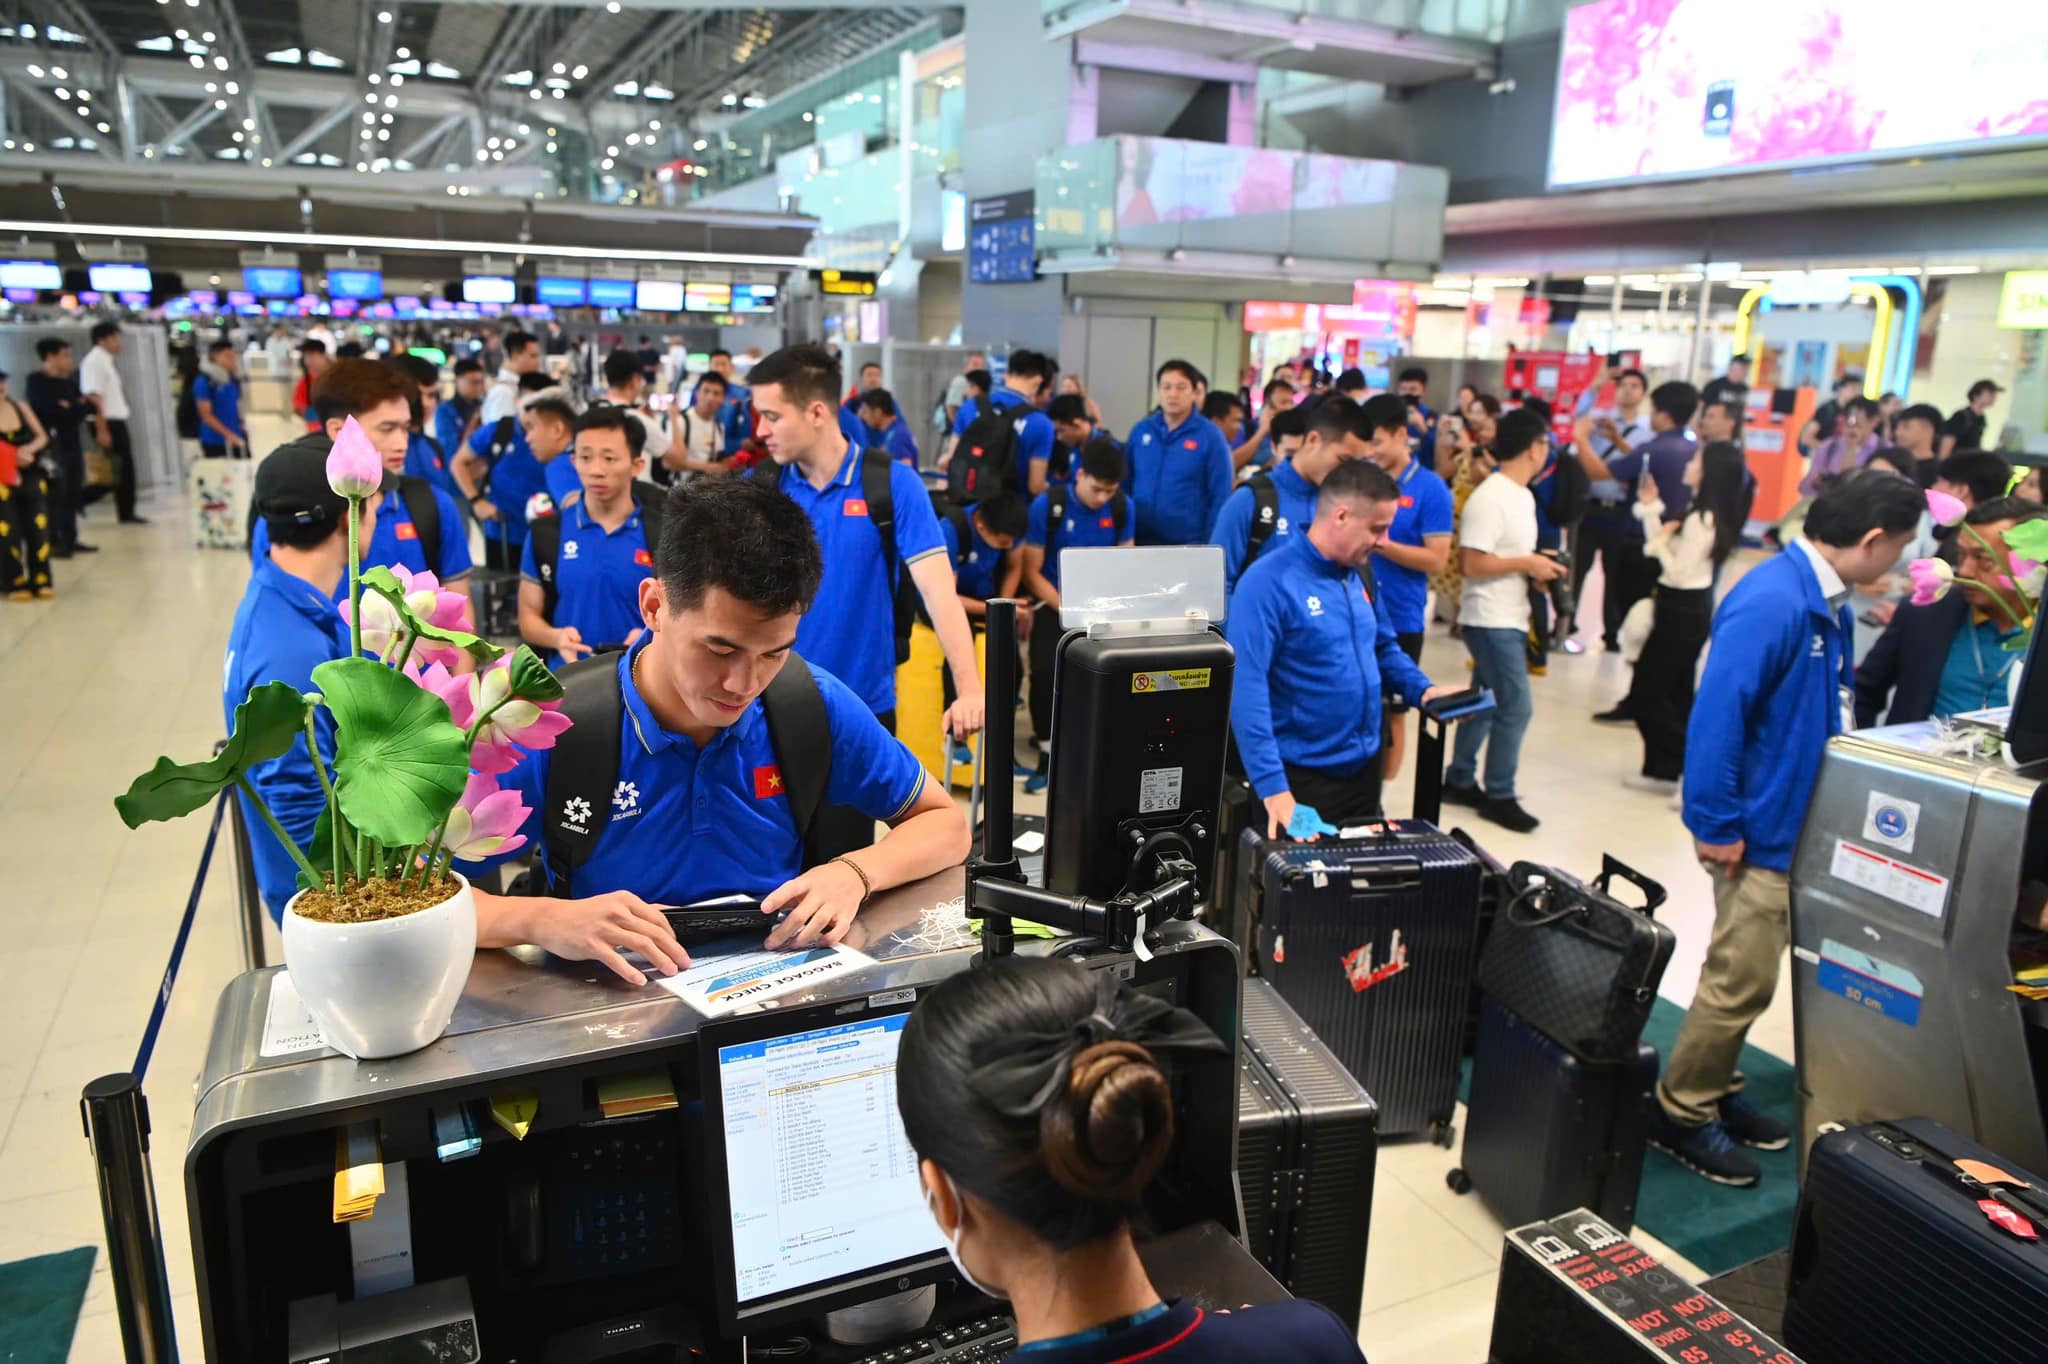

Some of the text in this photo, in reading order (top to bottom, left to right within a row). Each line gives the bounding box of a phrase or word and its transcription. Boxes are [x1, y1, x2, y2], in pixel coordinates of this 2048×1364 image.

[720, 960, 843, 1002] BAGGAGE CHECK
[1619, 1254, 1659, 1277] 32 KG
[1576, 1269, 1619, 1291] 32 KG
[1672, 1294, 1714, 1317] NOT
[606, 1323, 642, 1334] THALES
[1628, 1309, 1670, 1333] NOT
[1695, 1310, 1735, 1332] OVER
[1651, 1326, 1694, 1348] OVER
[1723, 1328, 1753, 1348] 85
[1679, 1345, 1709, 1364] 85
